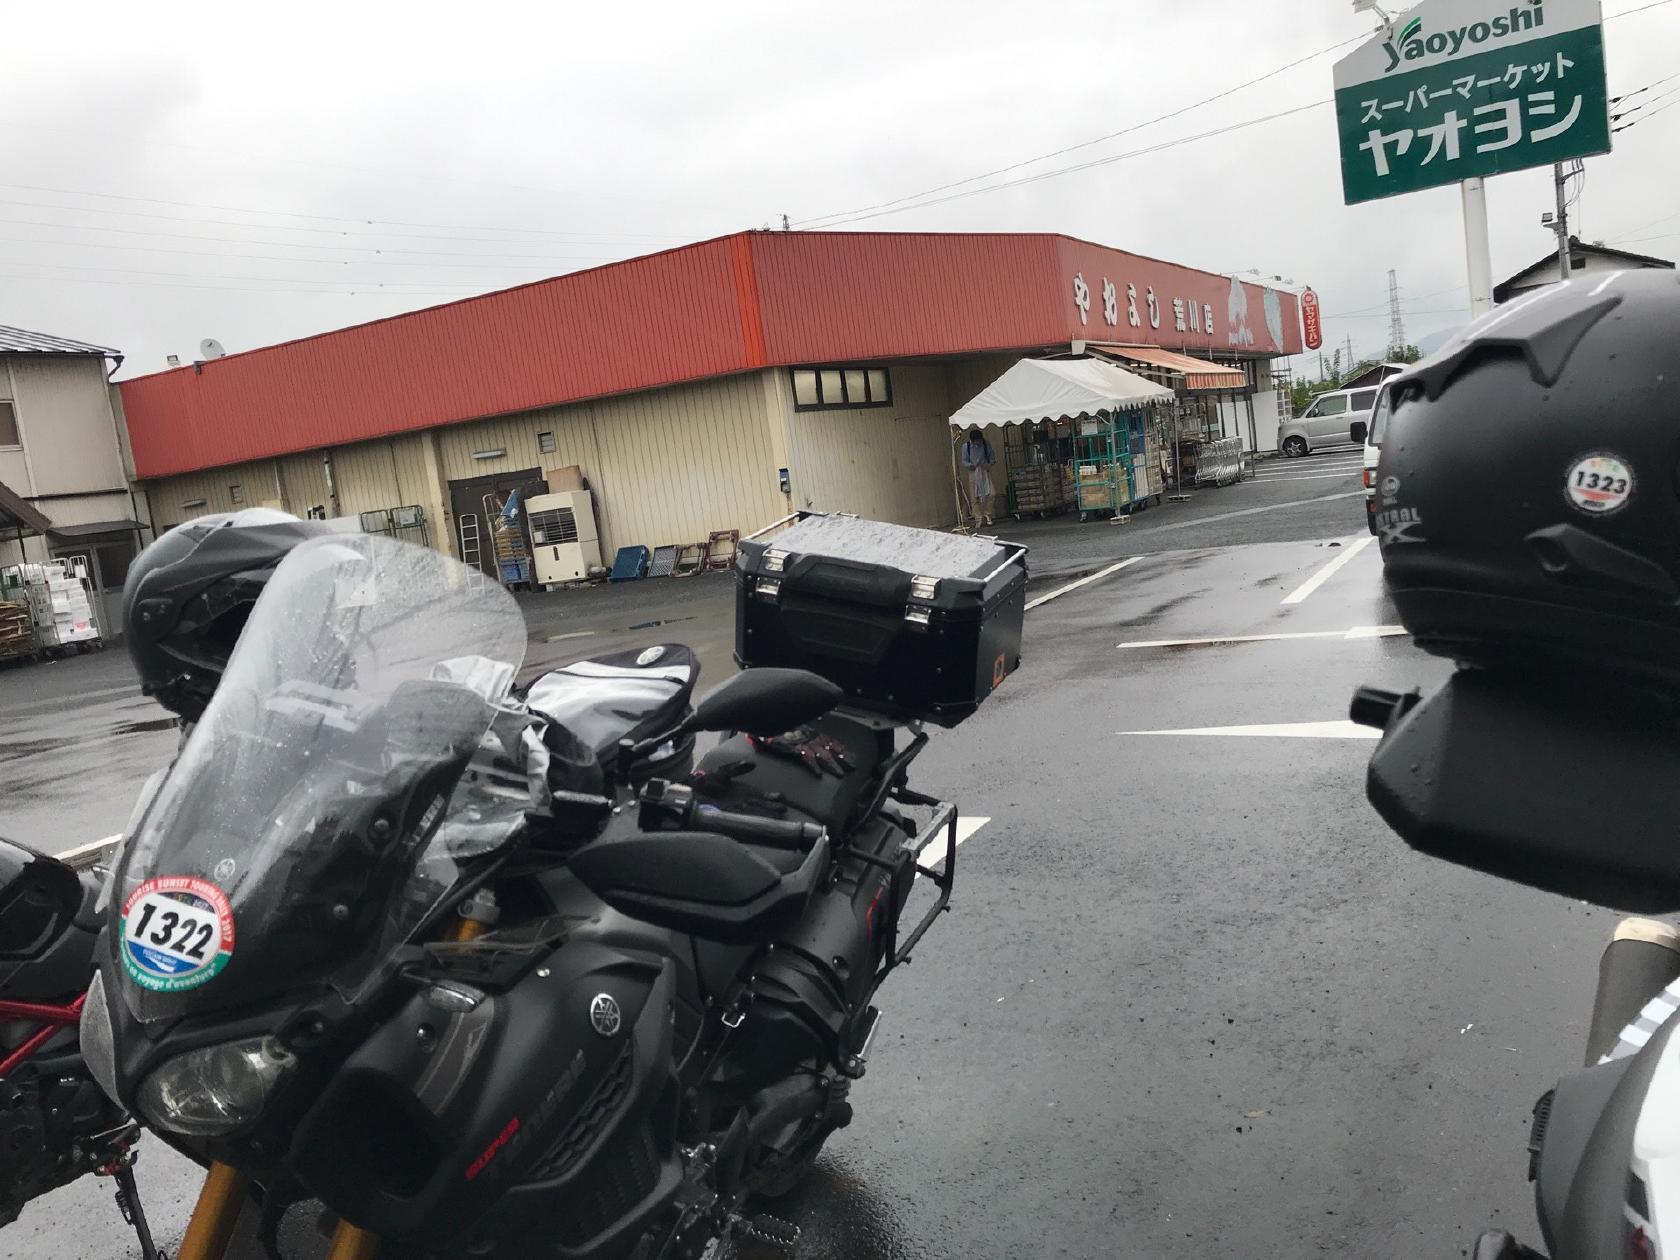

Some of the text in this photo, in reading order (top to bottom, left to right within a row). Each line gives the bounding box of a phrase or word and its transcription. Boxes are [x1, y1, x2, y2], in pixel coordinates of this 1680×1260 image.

[1382, 0, 1544, 73] Yaoyoshi
[1361, 52, 1575, 124] スーパーマーケット
[1359, 90, 1582, 177] ヤオヨシ
[1576, 471, 1627, 494] 1323
[134, 902, 214, 961] 1322
